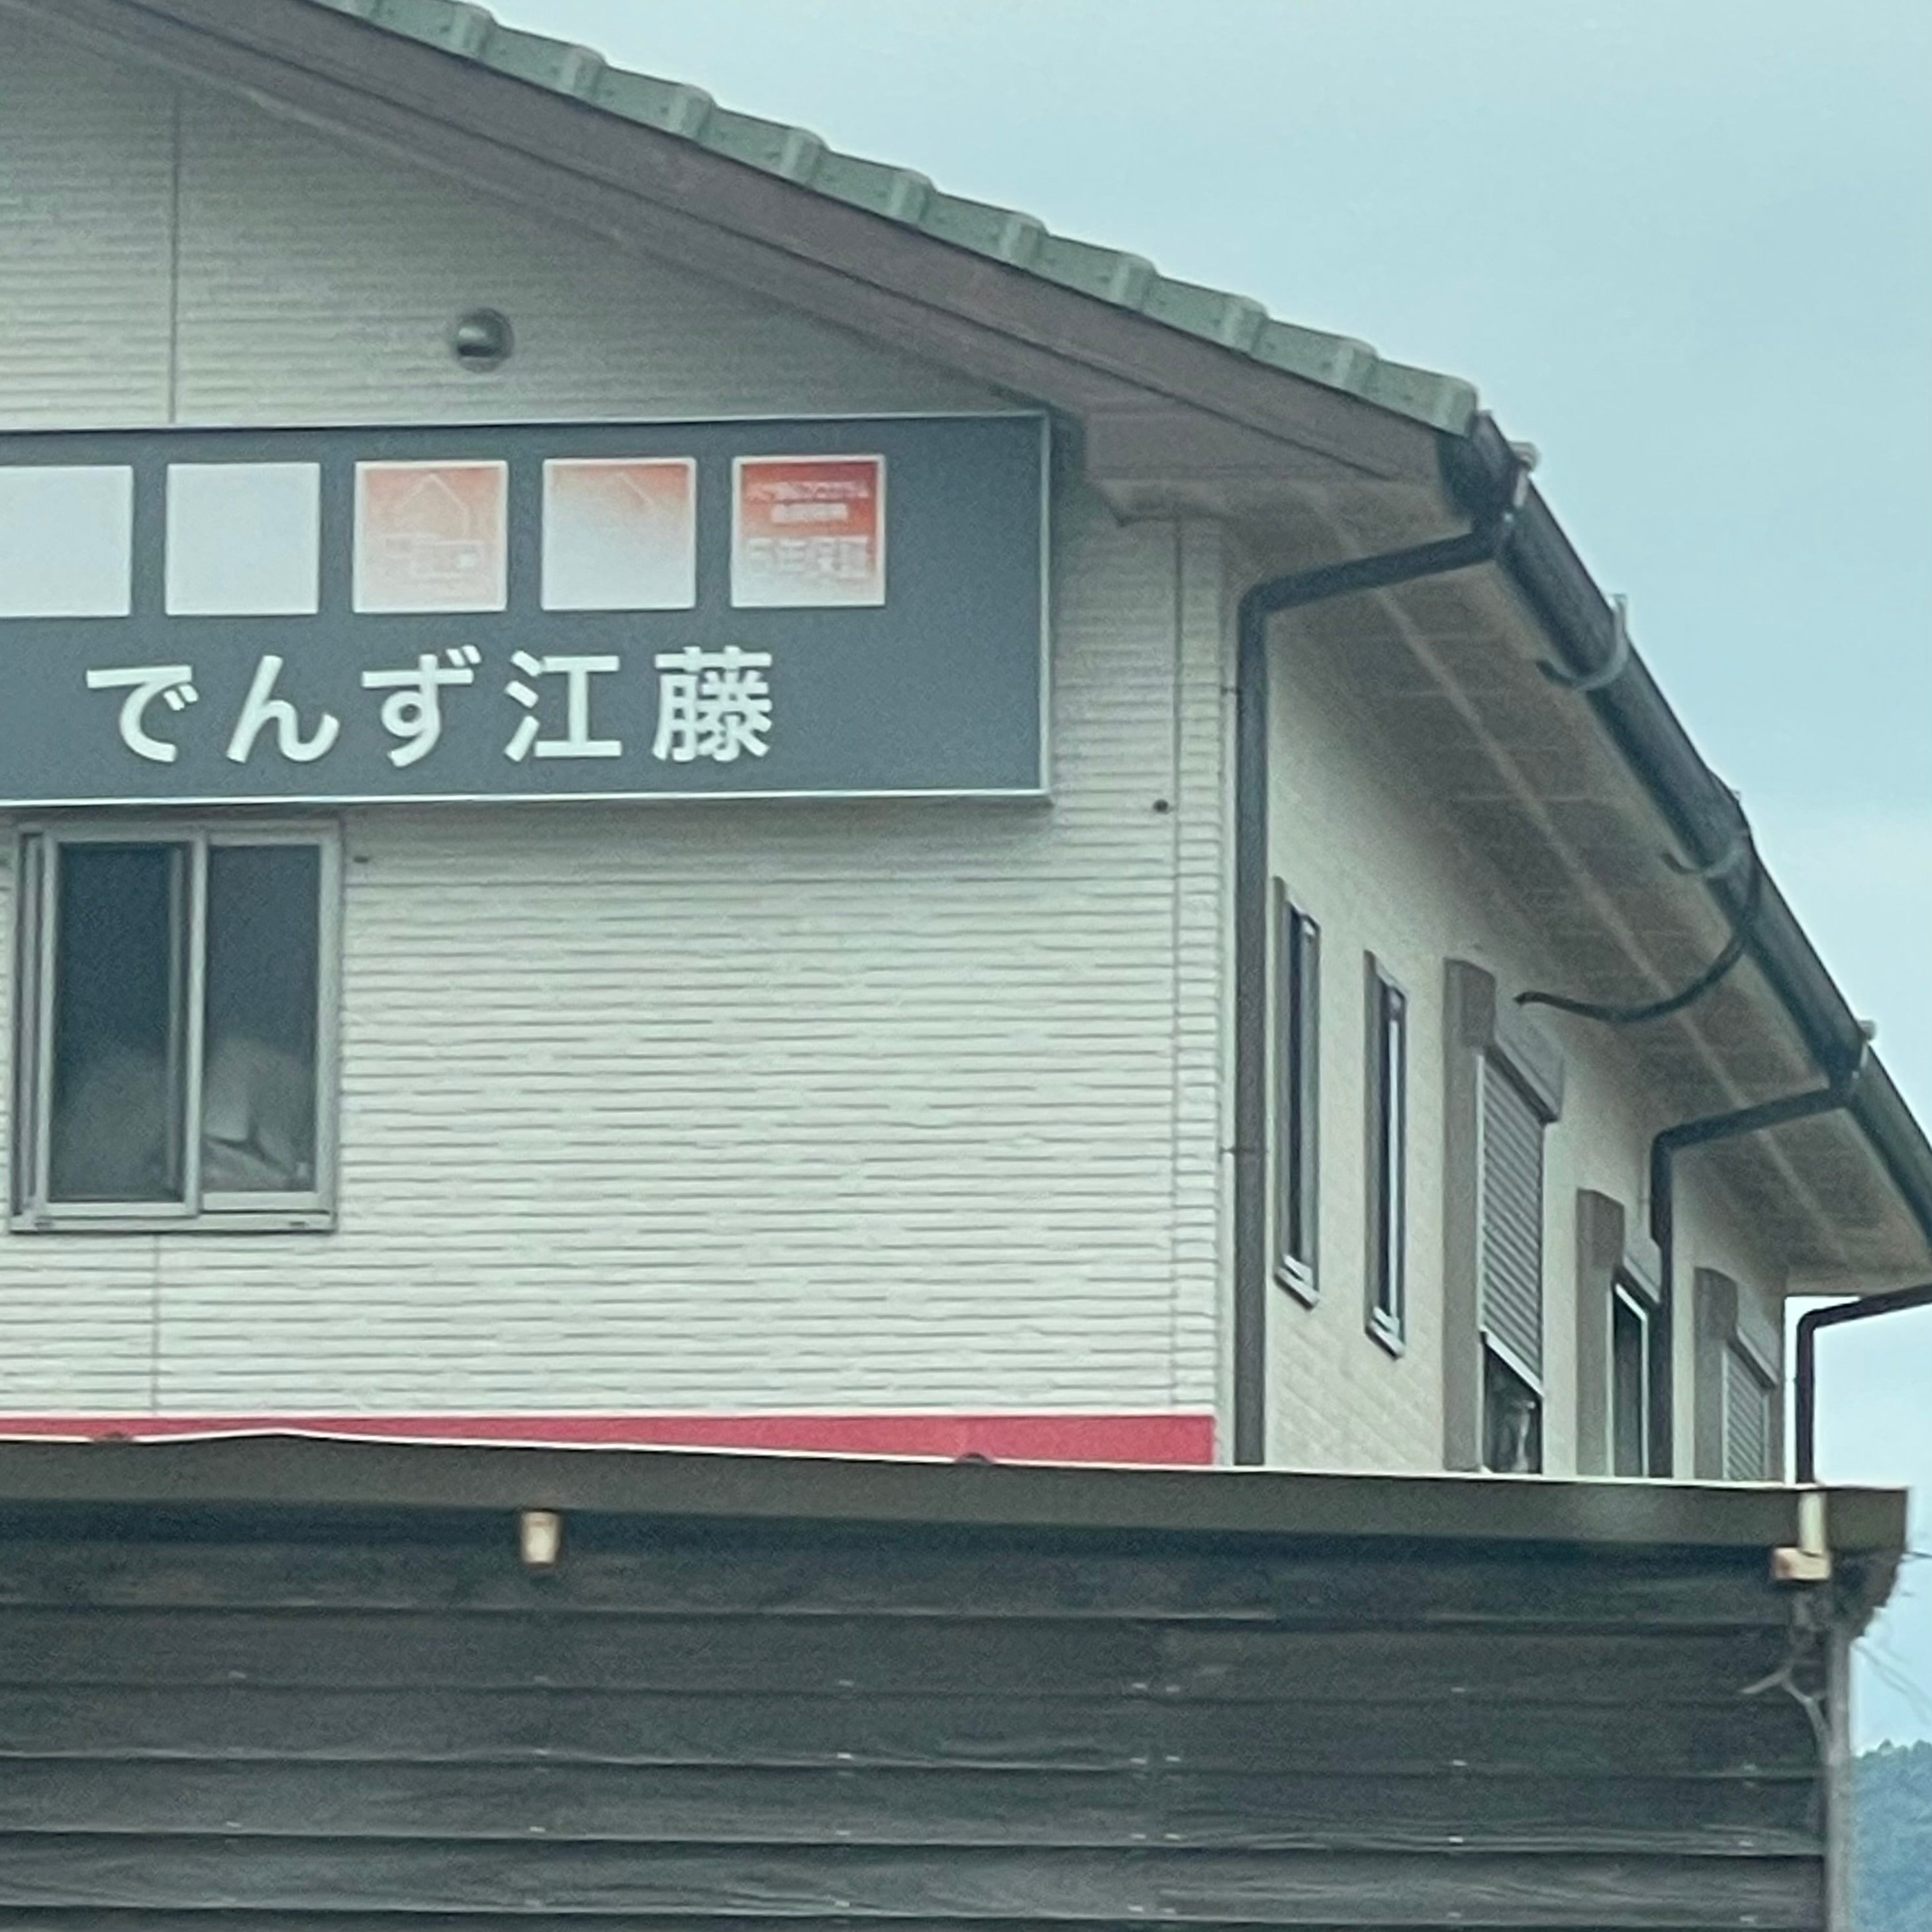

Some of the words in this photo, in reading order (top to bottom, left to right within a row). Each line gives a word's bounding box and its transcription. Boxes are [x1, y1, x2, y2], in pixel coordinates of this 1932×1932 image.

[85, 644, 773, 767] でんず江藤
